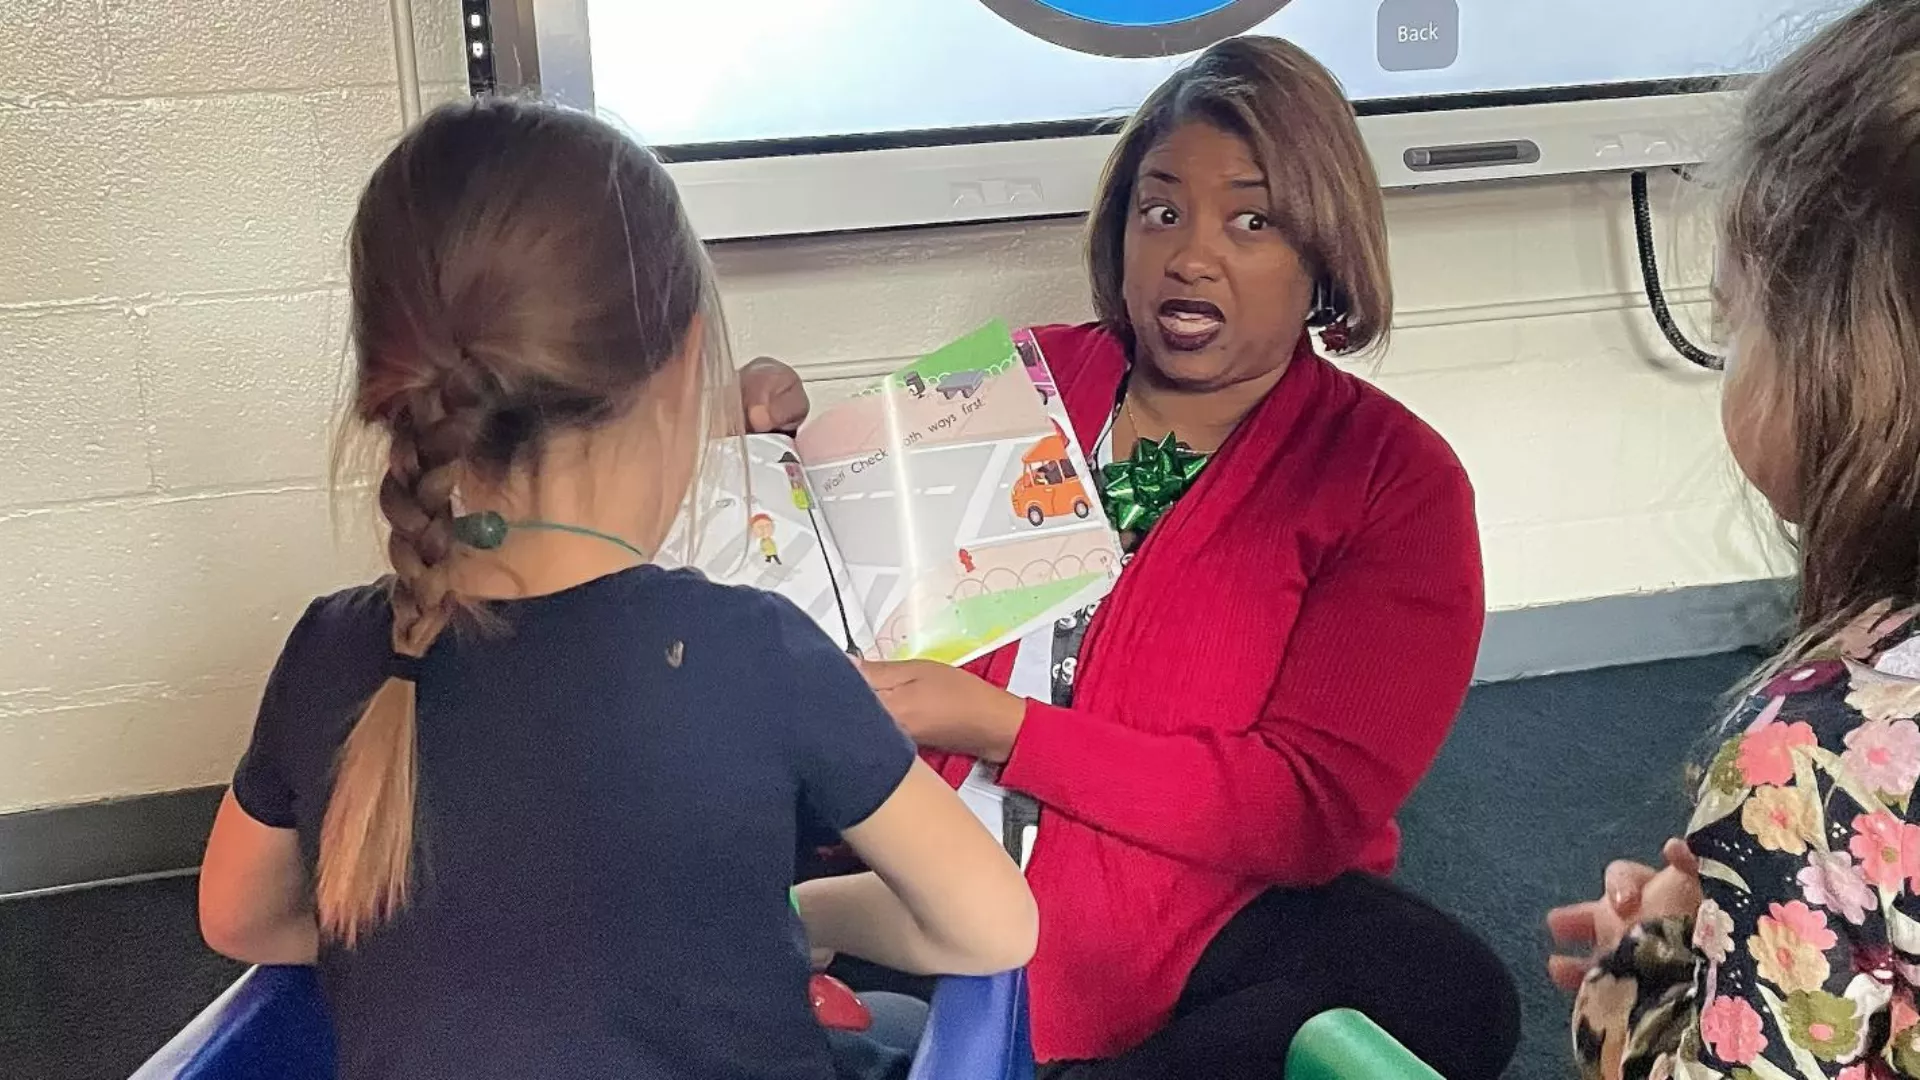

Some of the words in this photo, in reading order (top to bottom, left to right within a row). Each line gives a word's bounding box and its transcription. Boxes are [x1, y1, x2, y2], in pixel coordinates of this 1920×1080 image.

[1398, 21, 1439, 43] Back
[851, 448, 889, 473] Check
[901, 431, 923, 447] oth
[928, 413, 957, 433] ways
